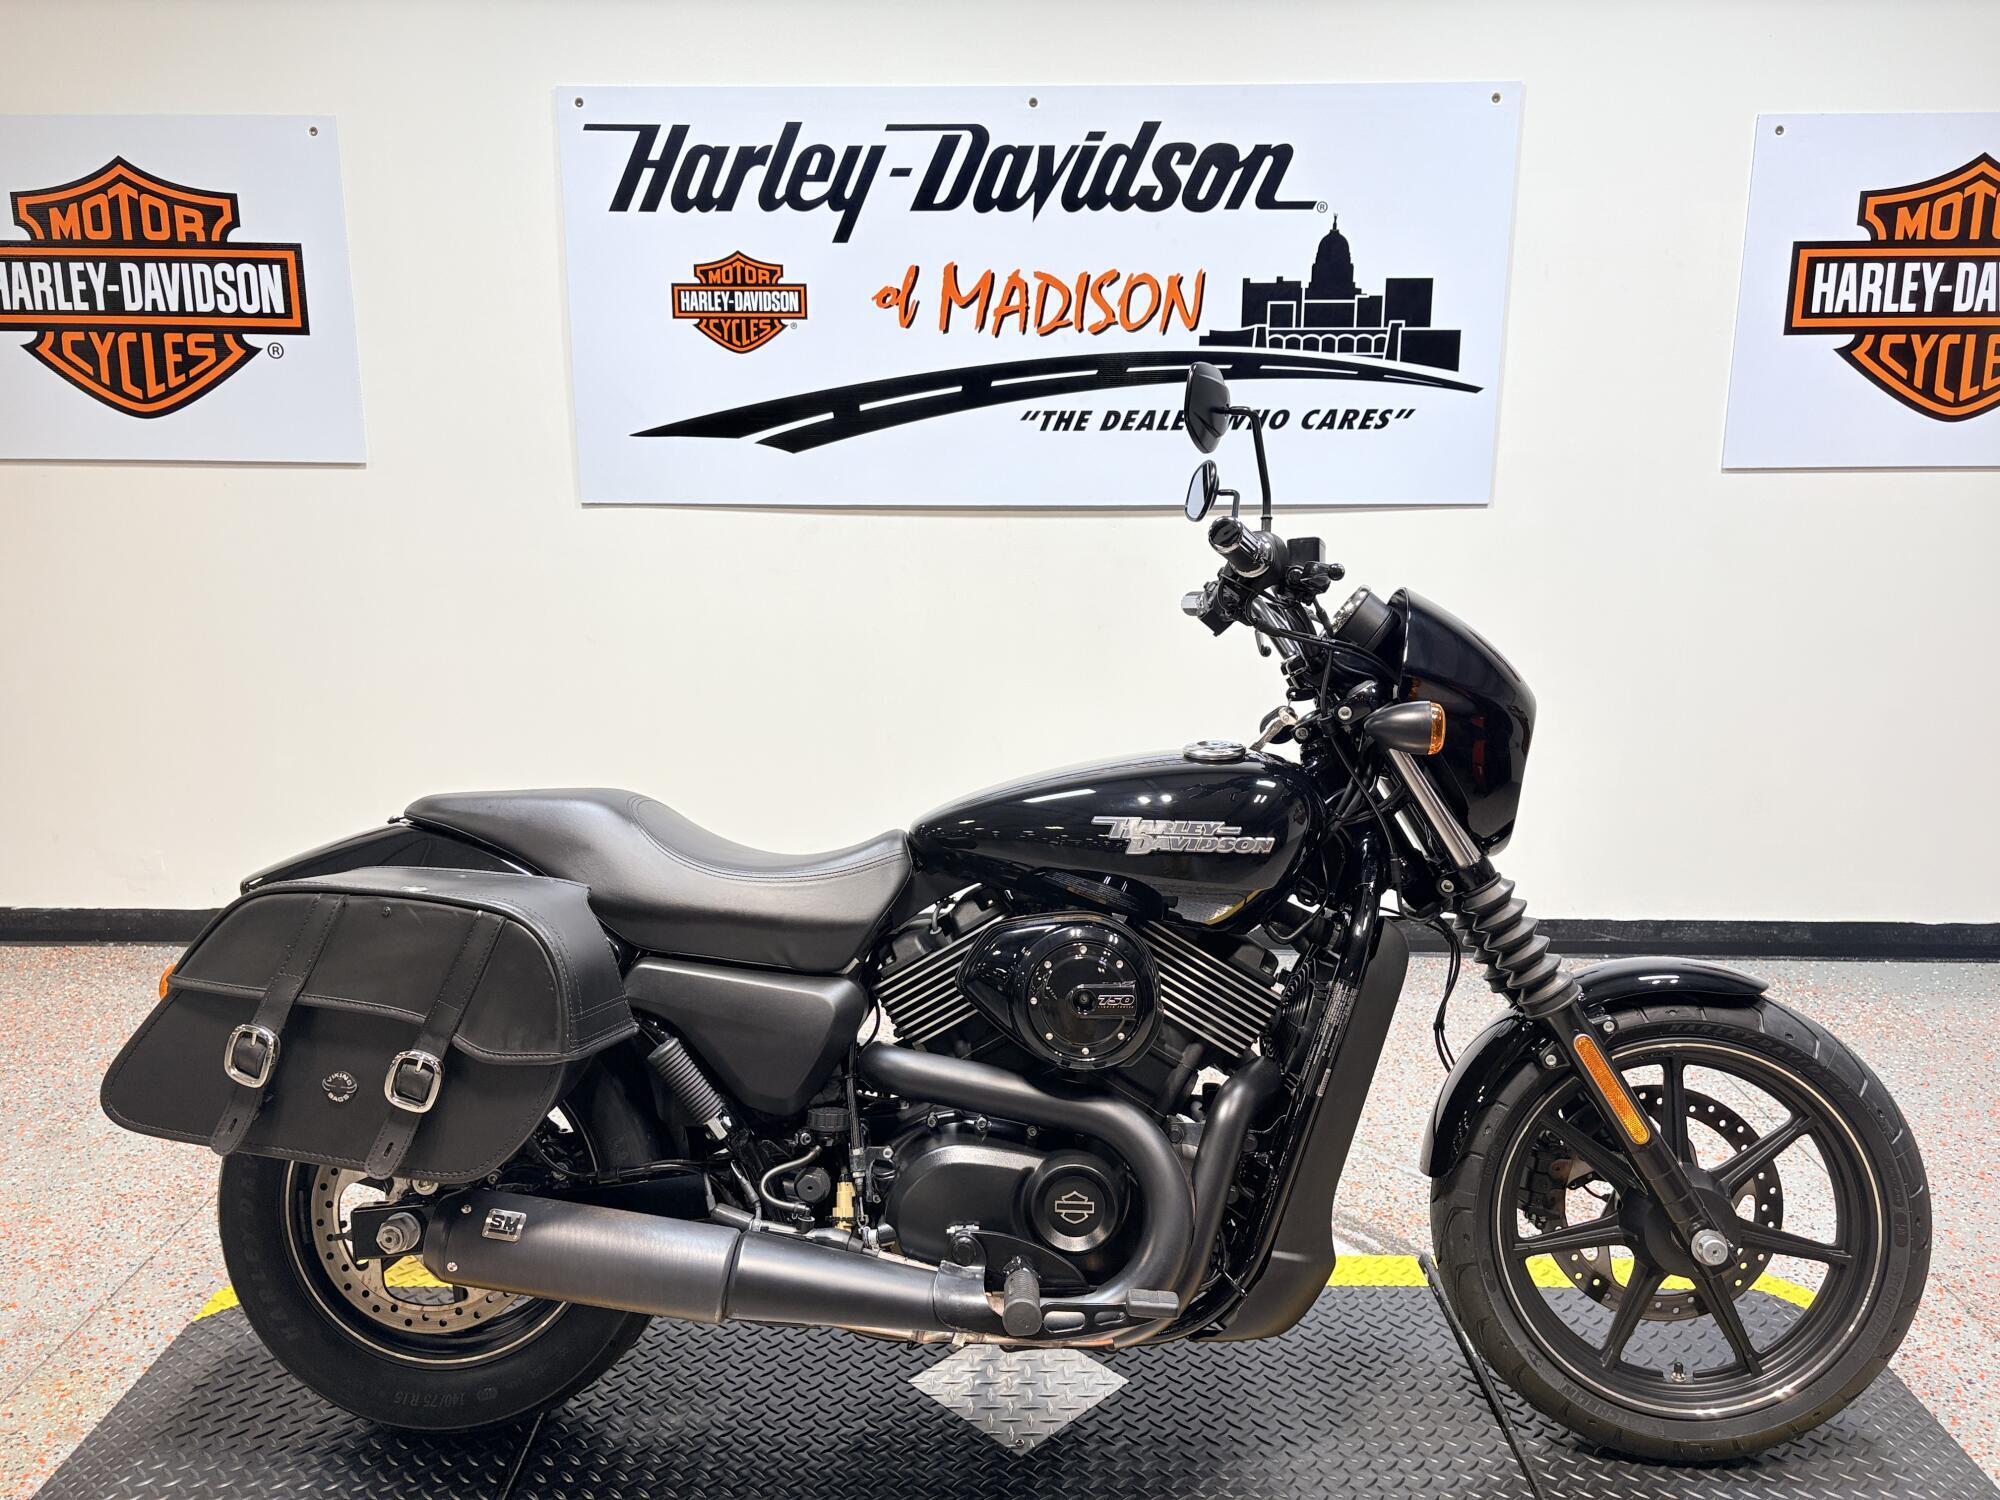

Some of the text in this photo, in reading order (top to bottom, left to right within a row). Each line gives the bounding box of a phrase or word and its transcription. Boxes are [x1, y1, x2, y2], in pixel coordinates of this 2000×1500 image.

[583, 121, 1318, 243] Harley-Davidson
[49, 182, 206, 242] MOTOR
[1895, 179, 2000, 240] MOT
[708, 261, 770, 284] MOTOR
[1811, 262, 2000, 314] HARLEY-DA
[680, 291, 800, 312] HARLEY-DAVIDSON
[938, 261, 1206, 338] MADISON
[709, 319, 772, 346] CYCLES
[61, 331, 216, 400] CYCLES
[1099, 409, 1187, 432] DEALE
[1125, 834, 1276, 855] DAVIDSON
[1098, 994, 1135, 1006] 750
